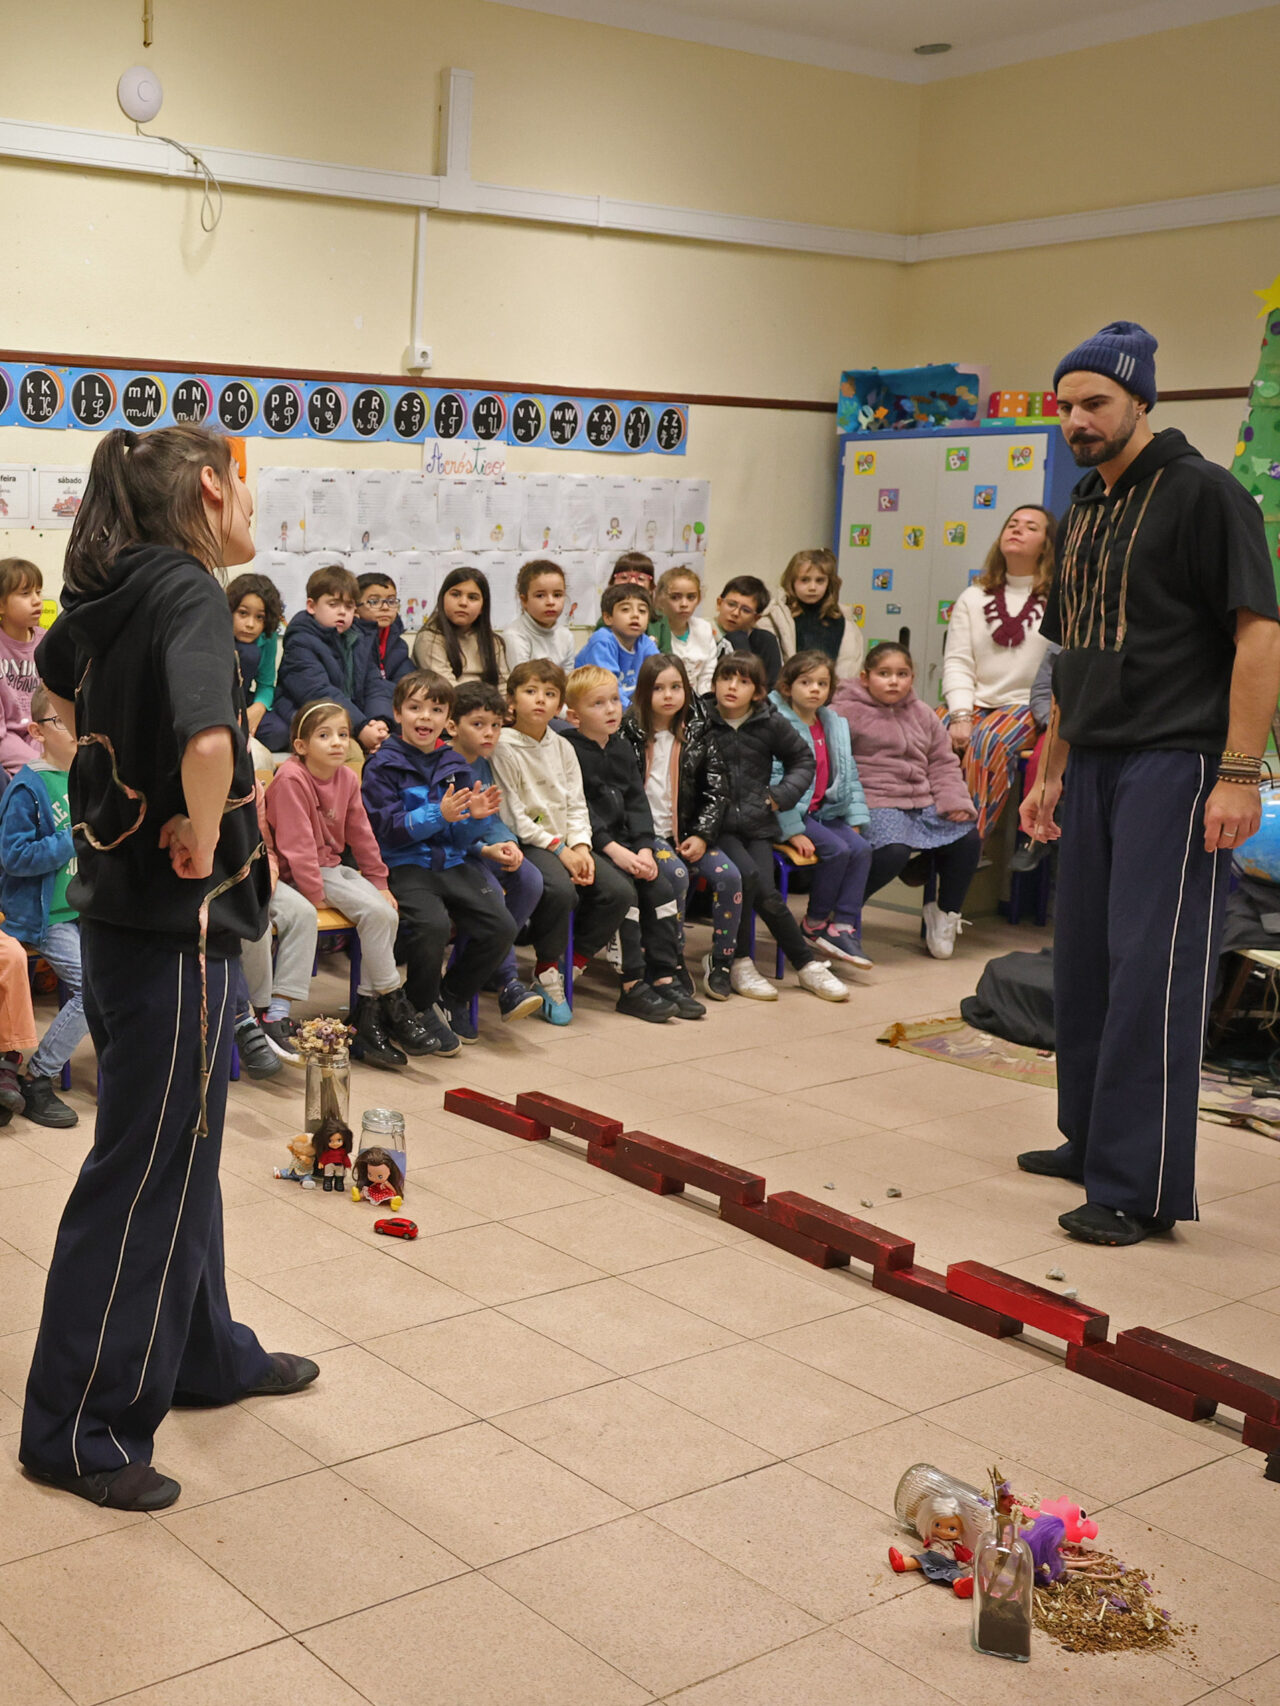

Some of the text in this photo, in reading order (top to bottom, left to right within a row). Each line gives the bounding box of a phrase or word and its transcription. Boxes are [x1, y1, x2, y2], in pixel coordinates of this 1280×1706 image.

[27, 378, 50, 394] k K
[95, 383, 103, 396] L
[129, 385, 156, 398] m M
[179, 387, 201, 400] n N
[225, 389, 247, 403] o O
[272, 392, 293, 407] p P
[313, 392, 335, 408] q Q
[360, 397, 379, 409] r R
[401, 399, 420, 412] s S
[442, 402, 458, 415] t T
[480, 400, 499, 415] u U
[518, 406, 537, 418] v V
[554, 407, 577, 421] w W
[593, 410, 612, 422] x X
[629, 410, 647, 425] y Y
[663, 414, 678, 426] z Z
[426, 441, 505, 476] Acróstico
[949, 454, 960, 468] B
[58, 476, 82, 484] sábado
